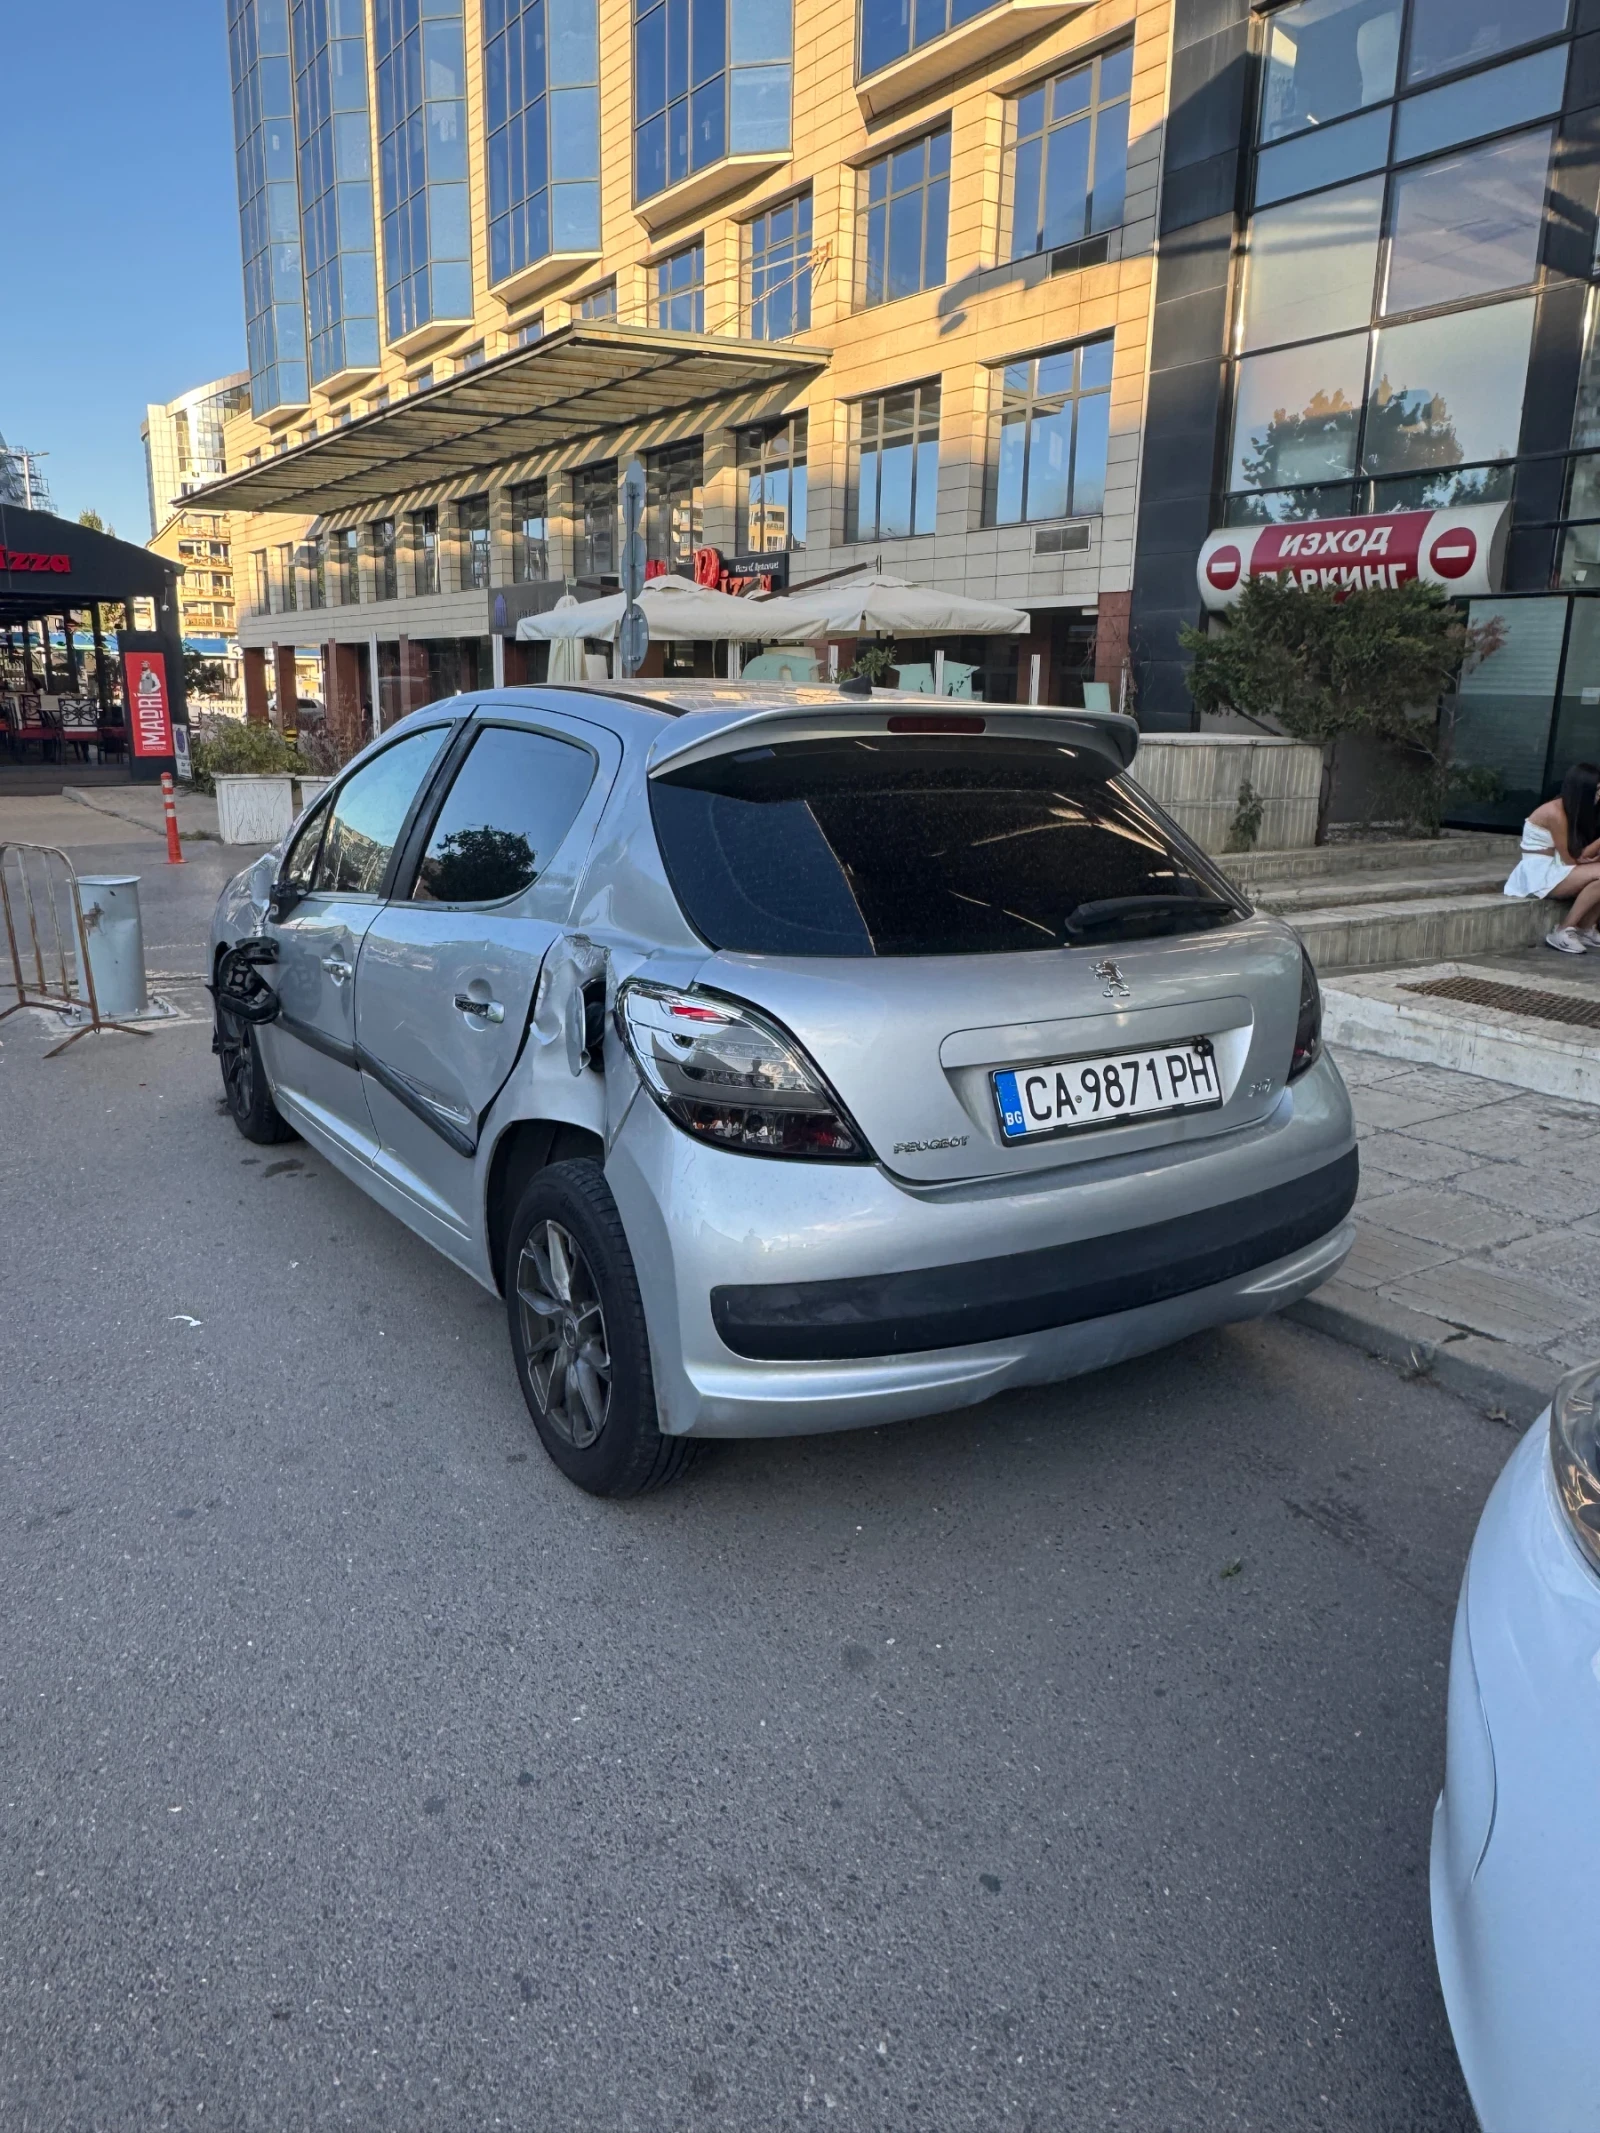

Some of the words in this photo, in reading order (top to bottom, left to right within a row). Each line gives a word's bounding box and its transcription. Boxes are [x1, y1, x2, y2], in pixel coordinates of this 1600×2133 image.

[1278, 526, 1393, 557] ИЗХОД
[1081, 1058, 1163, 1111] 9871
[1005, 1111, 1022, 1126] BG
[893, 1136, 970, 1154] PEUGEOT
